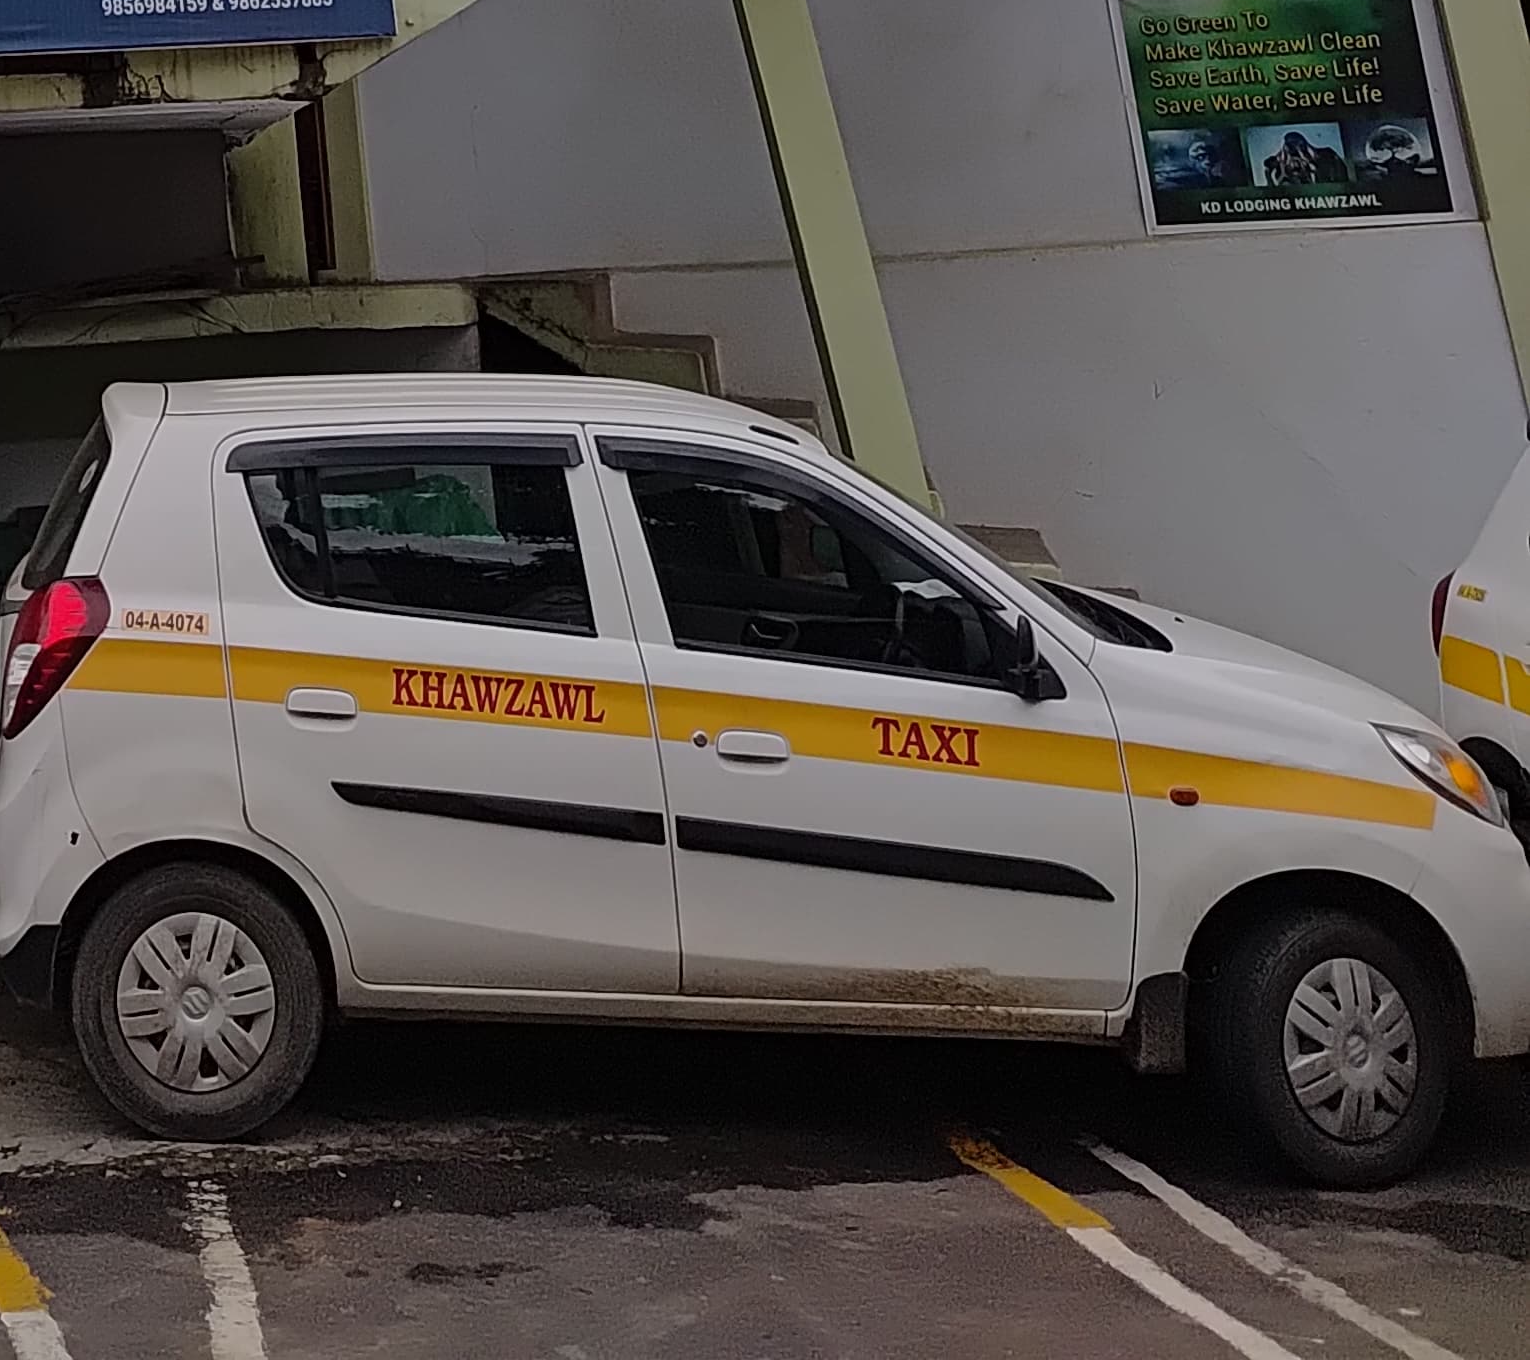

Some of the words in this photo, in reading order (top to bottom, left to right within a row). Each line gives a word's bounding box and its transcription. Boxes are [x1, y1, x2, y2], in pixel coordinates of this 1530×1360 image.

[1141, 17, 1169, 35] Go
[1175, 14, 1236, 33] Green
[1242, 10, 1268, 29] To
[1145, 42, 1202, 62] Make
[1208, 34, 1314, 58] Khawzawl
[1321, 32, 1381, 51] Clean
[1150, 70, 1200, 89] Save
[1206, 64, 1269, 86] Earth,
[1275, 63, 1327, 82] Save
[1333, 58, 1381, 78] Life!
[1155, 96, 1206, 115] Save
[1211, 91, 1278, 112] Water,
[1284, 89, 1336, 108] Save
[1342, 84, 1384, 104] Life
[1200, 201, 1221, 214] KD
[1225, 197, 1292, 213] LODGING
[1295, 194, 1382, 210] KHAWZAWL
[125, 611, 205, 633] 04-A-4074
[392, 668, 606, 724] KHAWZAWL
[871, 716, 980, 768] TAXI
